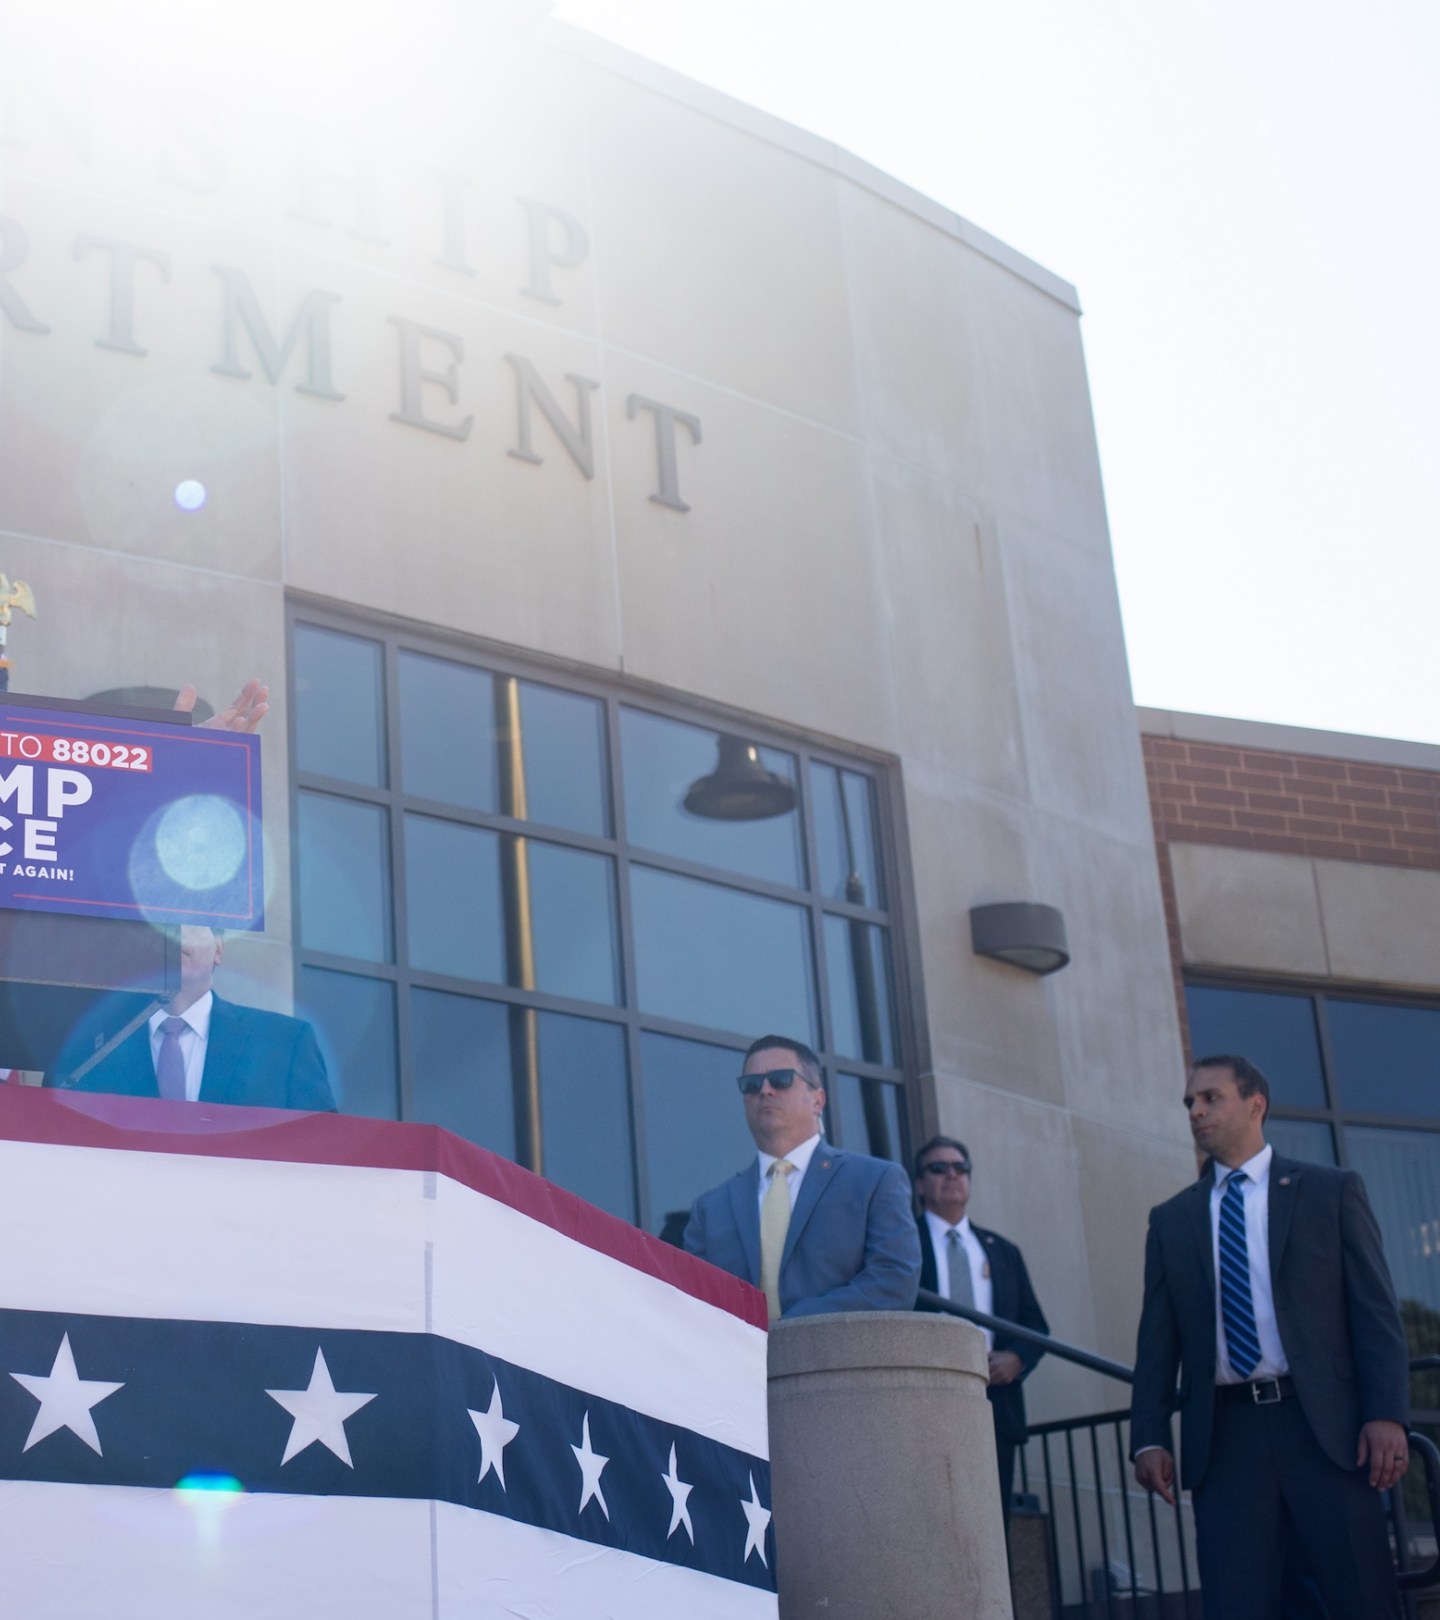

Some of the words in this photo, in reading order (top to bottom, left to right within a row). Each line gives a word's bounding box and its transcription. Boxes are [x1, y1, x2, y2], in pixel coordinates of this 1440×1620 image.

[1, 732, 42, 759] TO
[52, 739, 148, 771] 88022
[13, 864, 74, 881] AGAIN!
